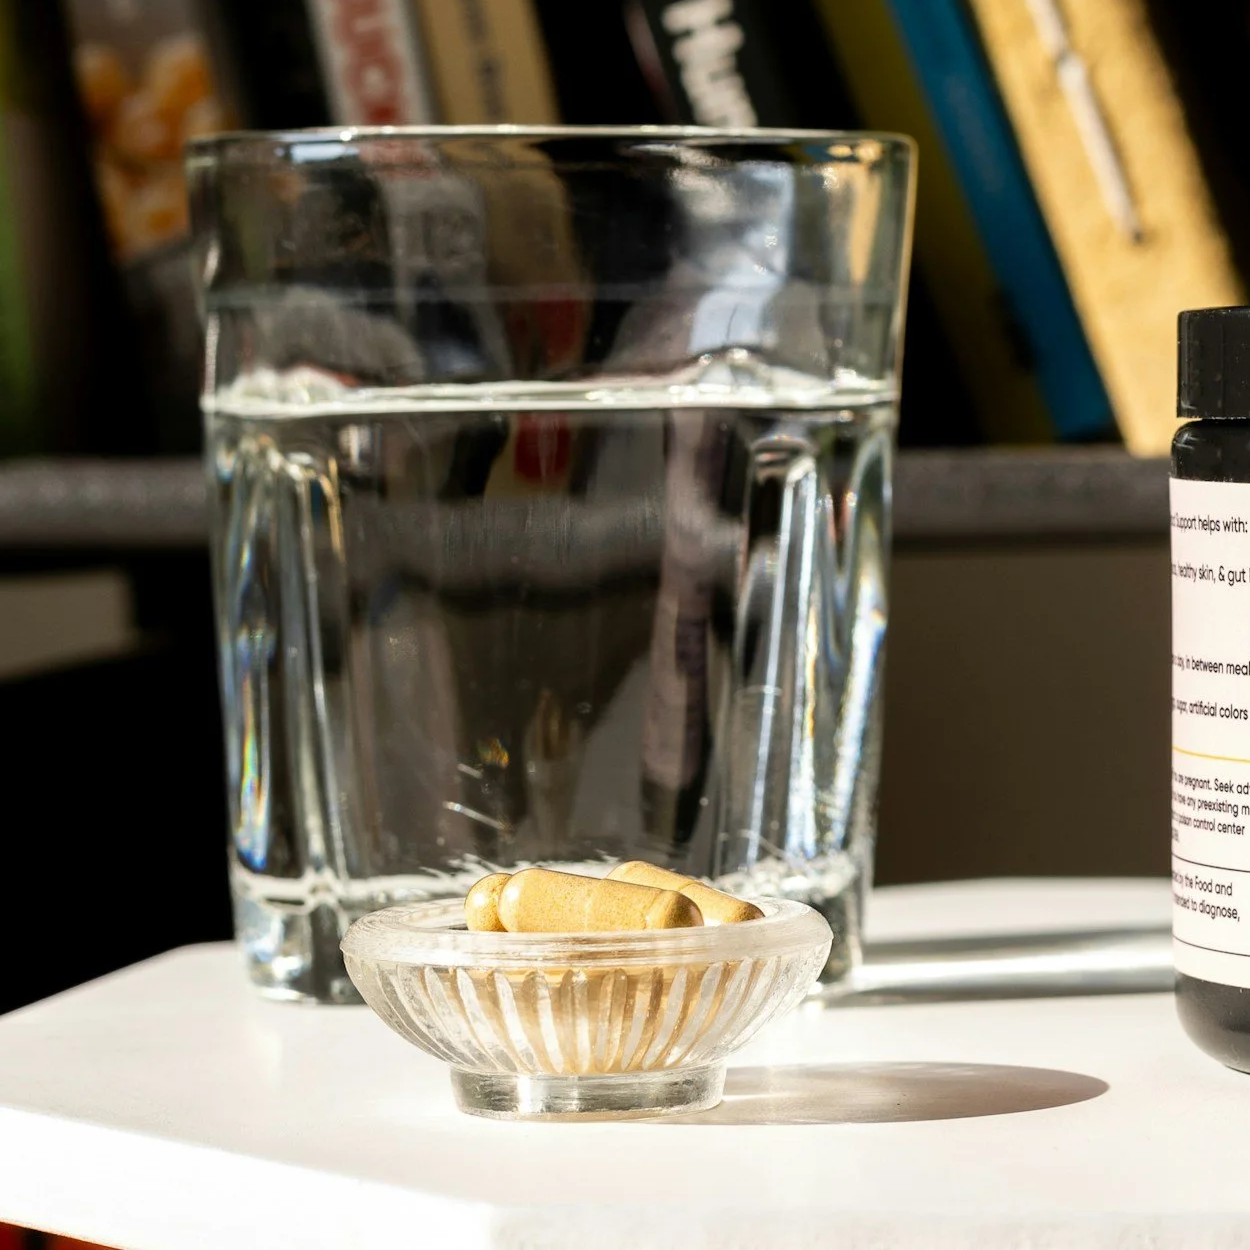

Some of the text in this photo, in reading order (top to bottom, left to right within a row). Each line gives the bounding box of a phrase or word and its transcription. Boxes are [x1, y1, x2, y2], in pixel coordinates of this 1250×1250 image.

[1198, 515, 1221, 536] helps
[1222, 516, 1248, 534] with:
[1199, 564, 1216, 584] skin,
[1218, 565, 1226, 582] &
[1227, 569, 1247, 587] gut
[1191, 656, 1224, 674] between
[1219, 703, 1248, 721] colors
[1214, 777, 1235, 794] Seek
[1197, 798, 1239, 818] preexisting
[1193, 816, 1216, 832] control
[1217, 822, 1246, 836] center
[1195, 875, 1213, 894] Food
[1215, 882, 1233, 897] and
[1199, 899, 1241, 923] diagnose,
